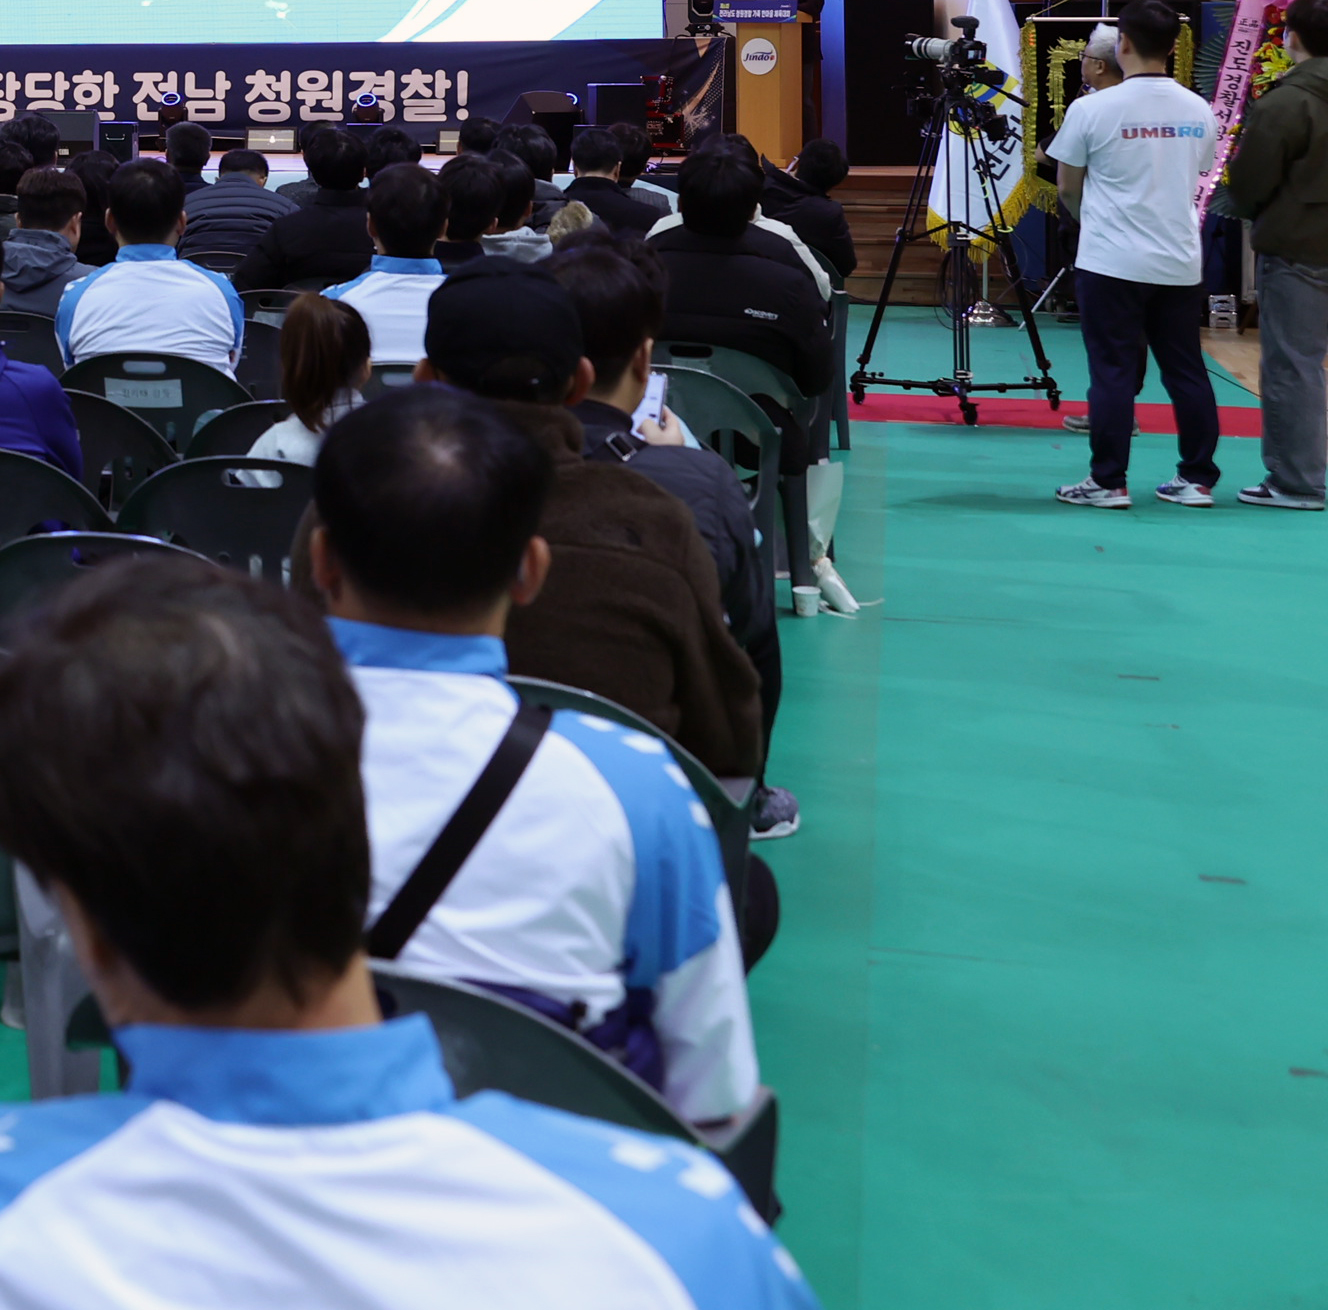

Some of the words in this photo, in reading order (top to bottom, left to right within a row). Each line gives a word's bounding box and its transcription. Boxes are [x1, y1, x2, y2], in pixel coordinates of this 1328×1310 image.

[743, 51, 771, 62] Jindo
[132, 69, 233, 123] 전남
[1121, 126, 1205, 140] UMBRO
